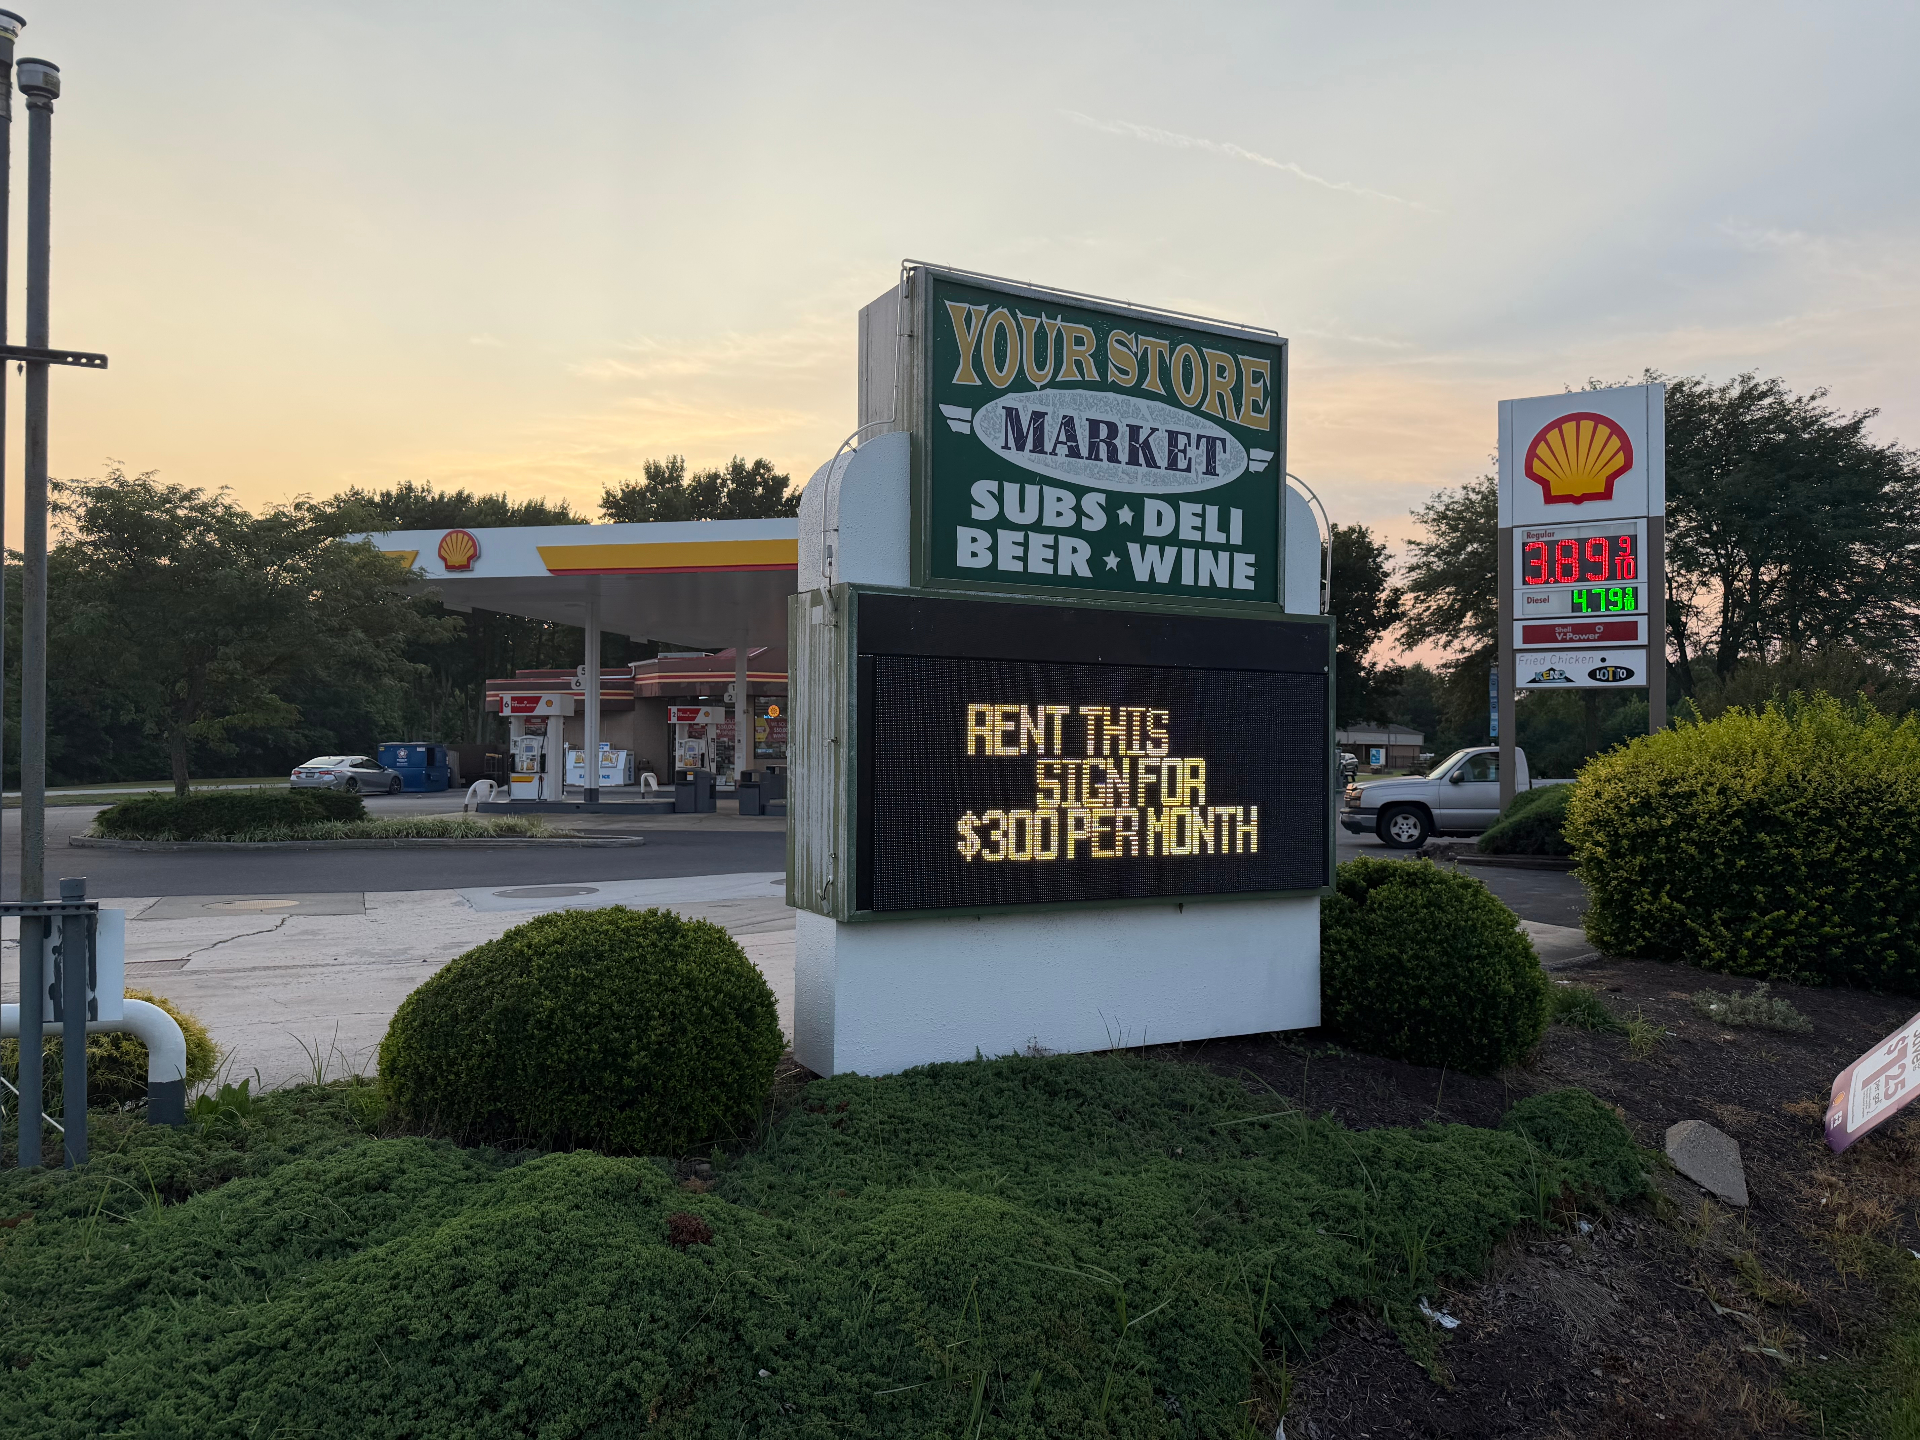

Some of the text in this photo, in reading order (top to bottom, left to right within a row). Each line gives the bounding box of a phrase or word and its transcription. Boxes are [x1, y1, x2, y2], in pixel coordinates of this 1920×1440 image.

[944, 300, 1271, 431] YOUR STORE
[1001, 405, 1226, 477] MARKET
[970, 479, 1243, 545] SUBS DELI
[1526, 531, 1555, 540] Regular
[956, 525, 1256, 591] BEER WINE
[1525, 537, 1610, 585] 3.89
[1526, 595, 1549, 604] Diesel
[1573, 588, 1623, 613] 4.79
[1555, 632, 1600, 641] V-Power
[1518, 654, 1594, 666] Fried Chicken
[575, 679, 582, 688] 6
[1535, 669, 1567, 681] KENO
[1596, 666, 1627, 681] LOTTO
[728, 694, 733, 702] 2
[967, 703, 1170, 757] RENT THIS
[1036, 757, 1206, 809] SIGN FOR
[956, 805, 1258, 862] $300 PER MONTH
